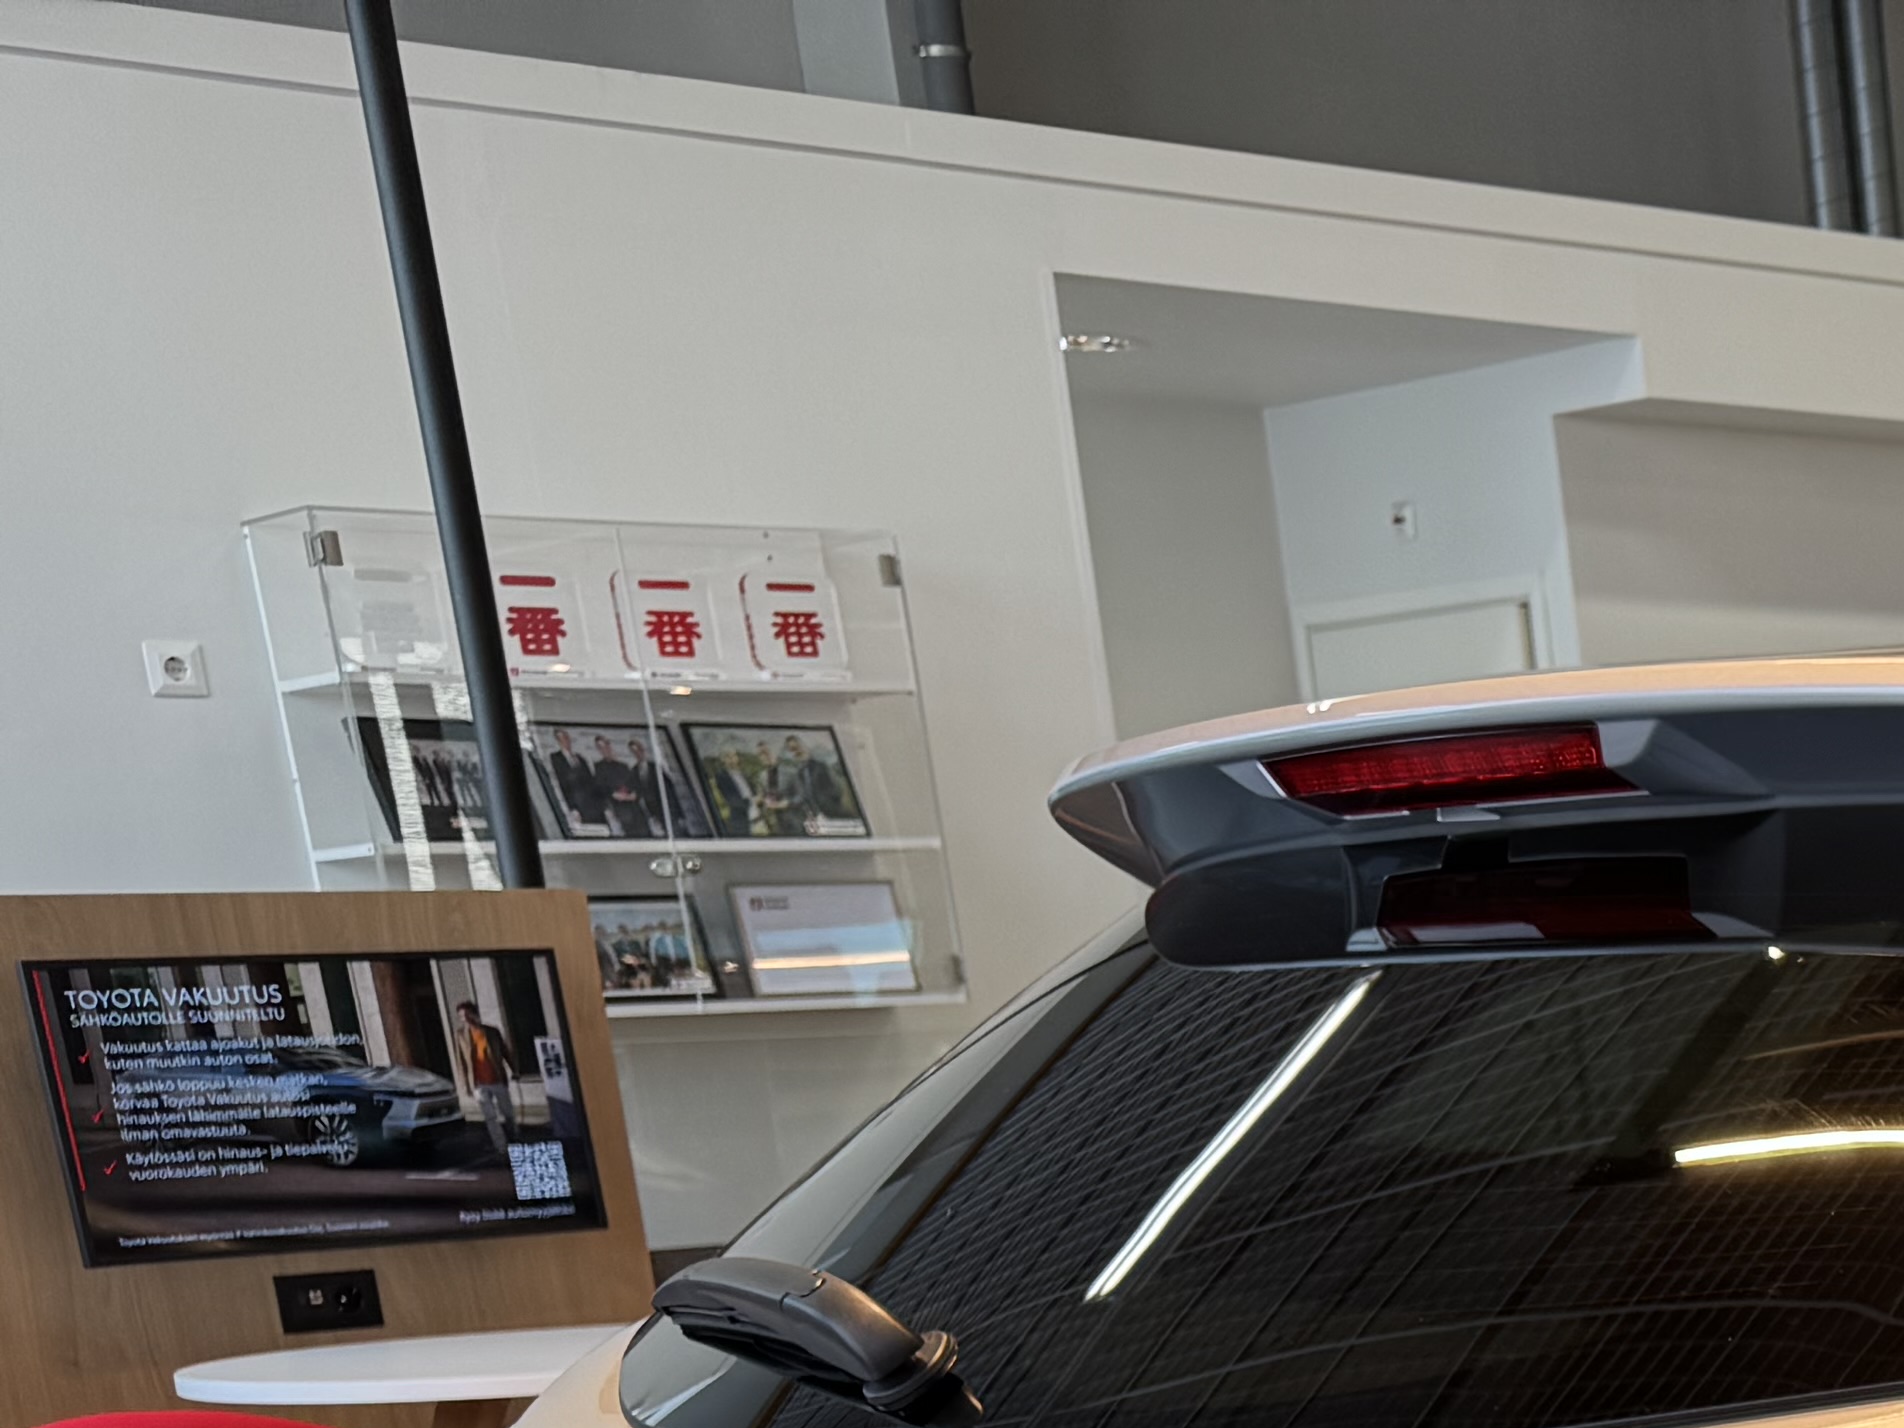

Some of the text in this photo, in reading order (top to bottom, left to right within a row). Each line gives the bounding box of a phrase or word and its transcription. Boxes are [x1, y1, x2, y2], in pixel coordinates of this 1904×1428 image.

[64, 984, 283, 1010] TOYOTA VAKUUTUS
[189, 1007, 285, 1025] SUUNNITELTU
[100, 1041, 162, 1055] Vakuutus
[166, 1039, 208, 1052] kattaa
[104, 1057, 143, 1070] kuten
[146, 1055, 201, 1068] muutkin
[204, 1053, 243, 1067] auton
[111, 1081, 133, 1095] Jos
[177, 1077, 225, 1093] loppuu
[113, 1097, 159, 1111] korvaa
[161, 1094, 206, 1110] Toyota
[207, 1091, 267, 1106] Vakuutus
[116, 1111, 186, 1126] hinauksen
[198, 1149, 216, 1162] on
[217, 1145, 268, 1160] hinaus-
[129, 1165, 217, 1182] vuorokauden
